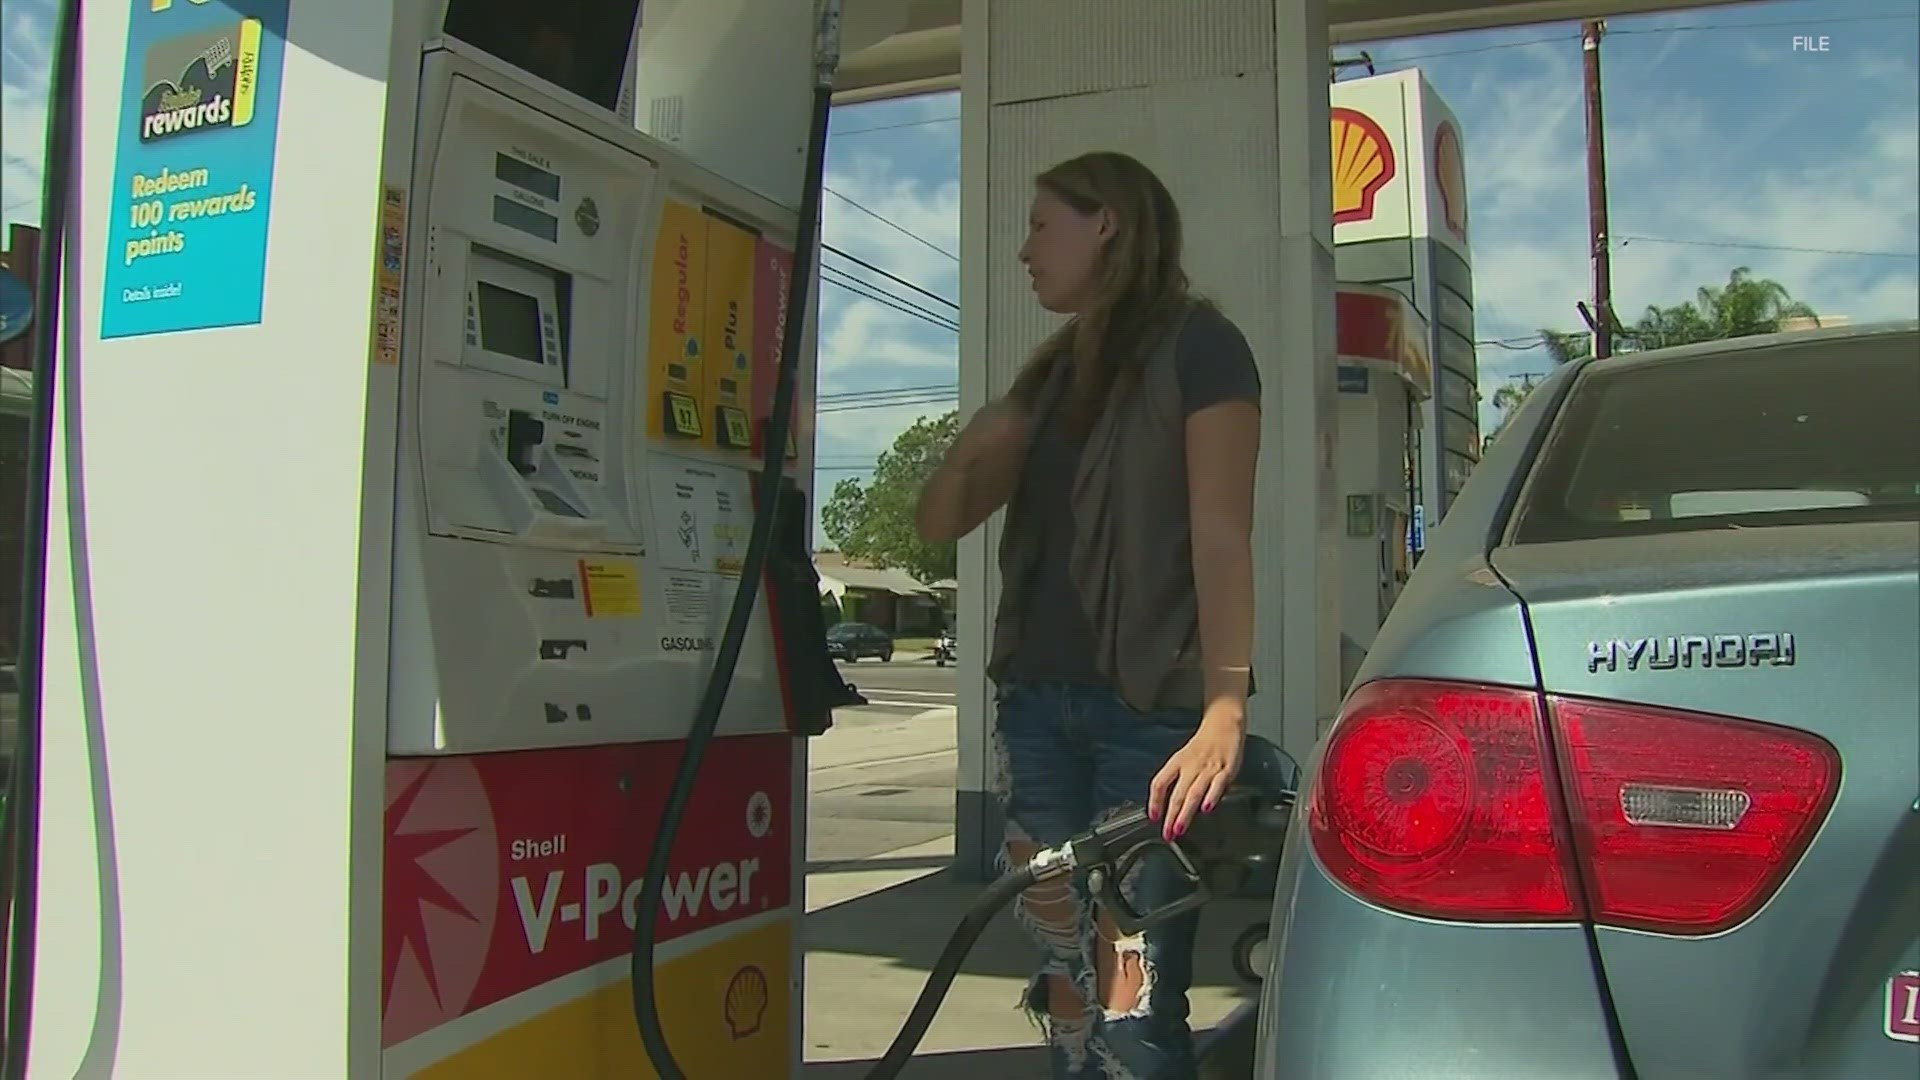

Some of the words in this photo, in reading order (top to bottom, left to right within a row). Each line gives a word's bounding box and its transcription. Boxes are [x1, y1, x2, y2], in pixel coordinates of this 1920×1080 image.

[143, 93, 231, 138] rewards
[131, 166, 208, 199] Redeem
[129, 201, 164, 229] 100
[167, 183, 257, 223] rewards
[124, 230, 185, 266] points
[672, 233, 690, 334] Regular
[724, 300, 738, 350] Plus
[562, 414, 575, 425] OFF
[576, 417, 600, 431] ENGINE
[660, 636, 715, 652] GASOLINE
[1587, 632, 1796, 674] HYUNDAI
[511, 834, 567, 861] Shell
